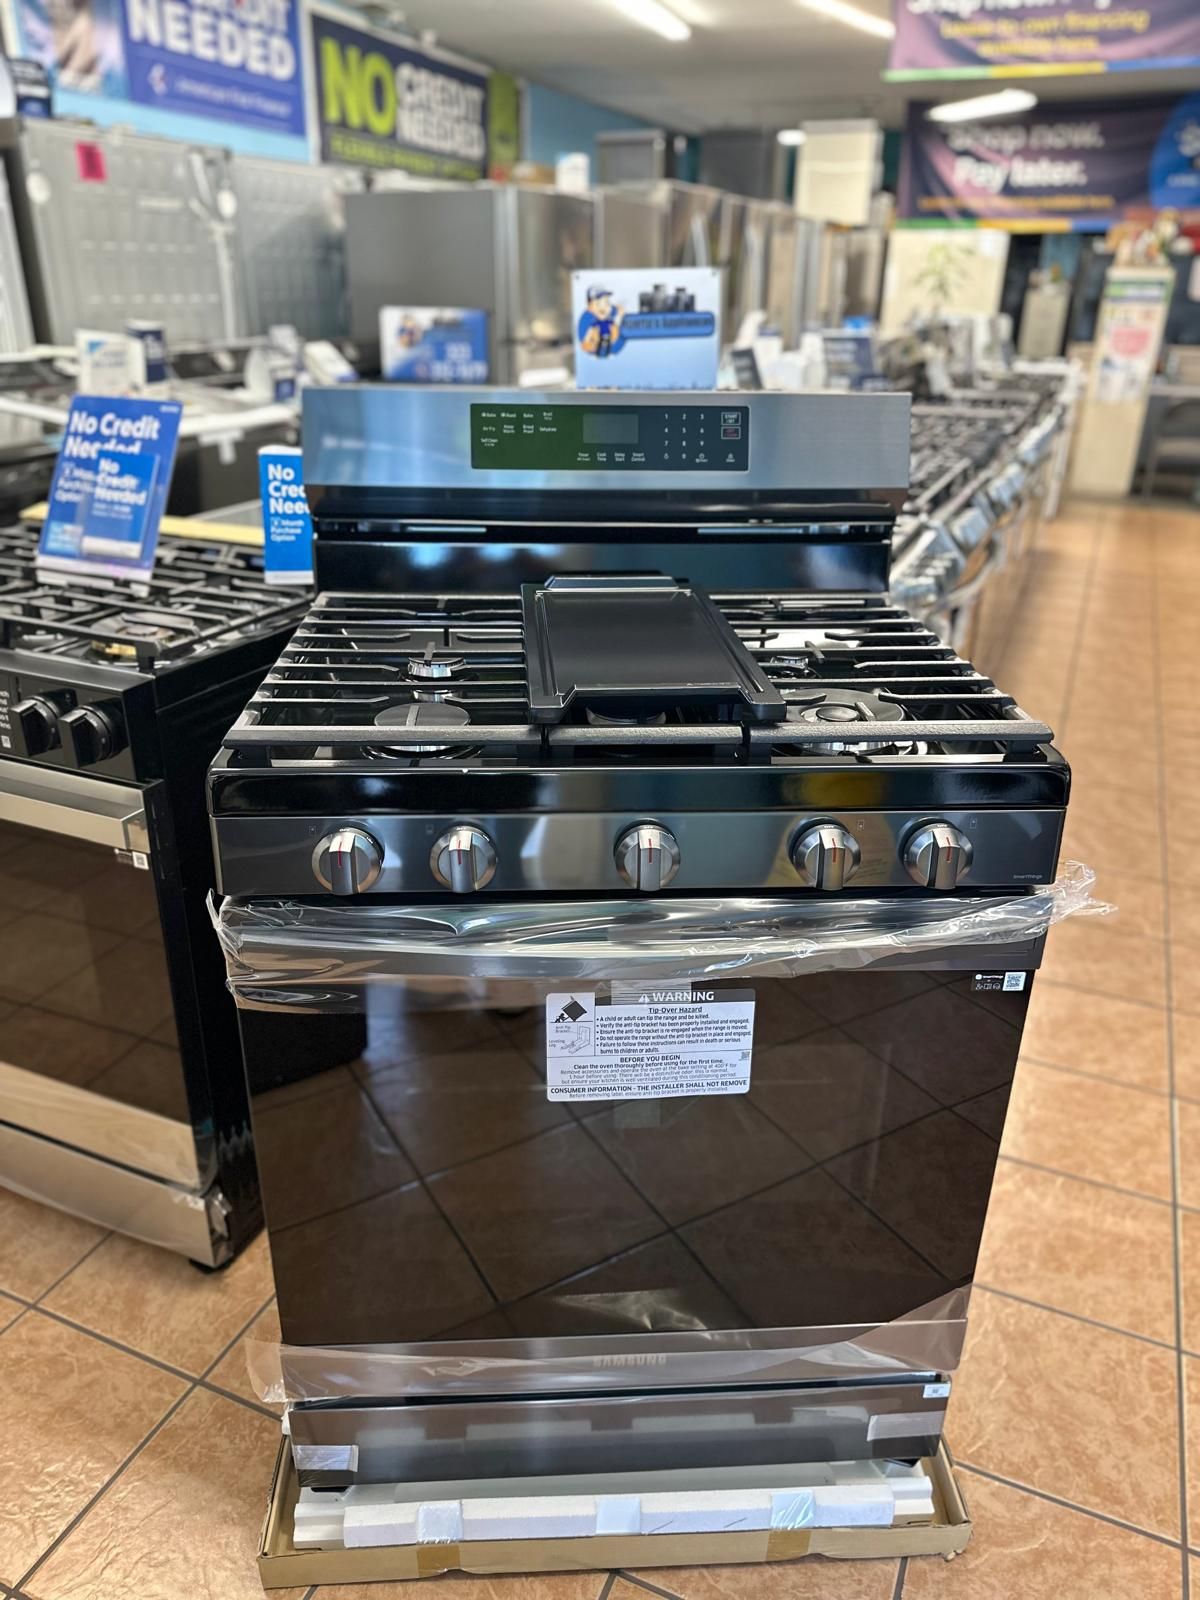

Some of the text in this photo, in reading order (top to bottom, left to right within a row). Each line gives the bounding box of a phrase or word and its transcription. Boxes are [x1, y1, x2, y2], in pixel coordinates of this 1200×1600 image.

[130, 0, 295, 82] NEEDED
[320, 36, 397, 136] NO
[395, 62, 484, 124] CREDIT
[396, 108, 486, 160] NEEDED
[954, 155, 1009, 193] Pay
[69, 410, 161, 440] No Credit
[99, 458, 120, 474] No
[267, 463, 295, 481] No
[96, 472, 139, 490] Credit
[94, 486, 147, 506] Needed
[652, 991, 714, 1002] WARNING
[664, 1060, 679, 1068] using
